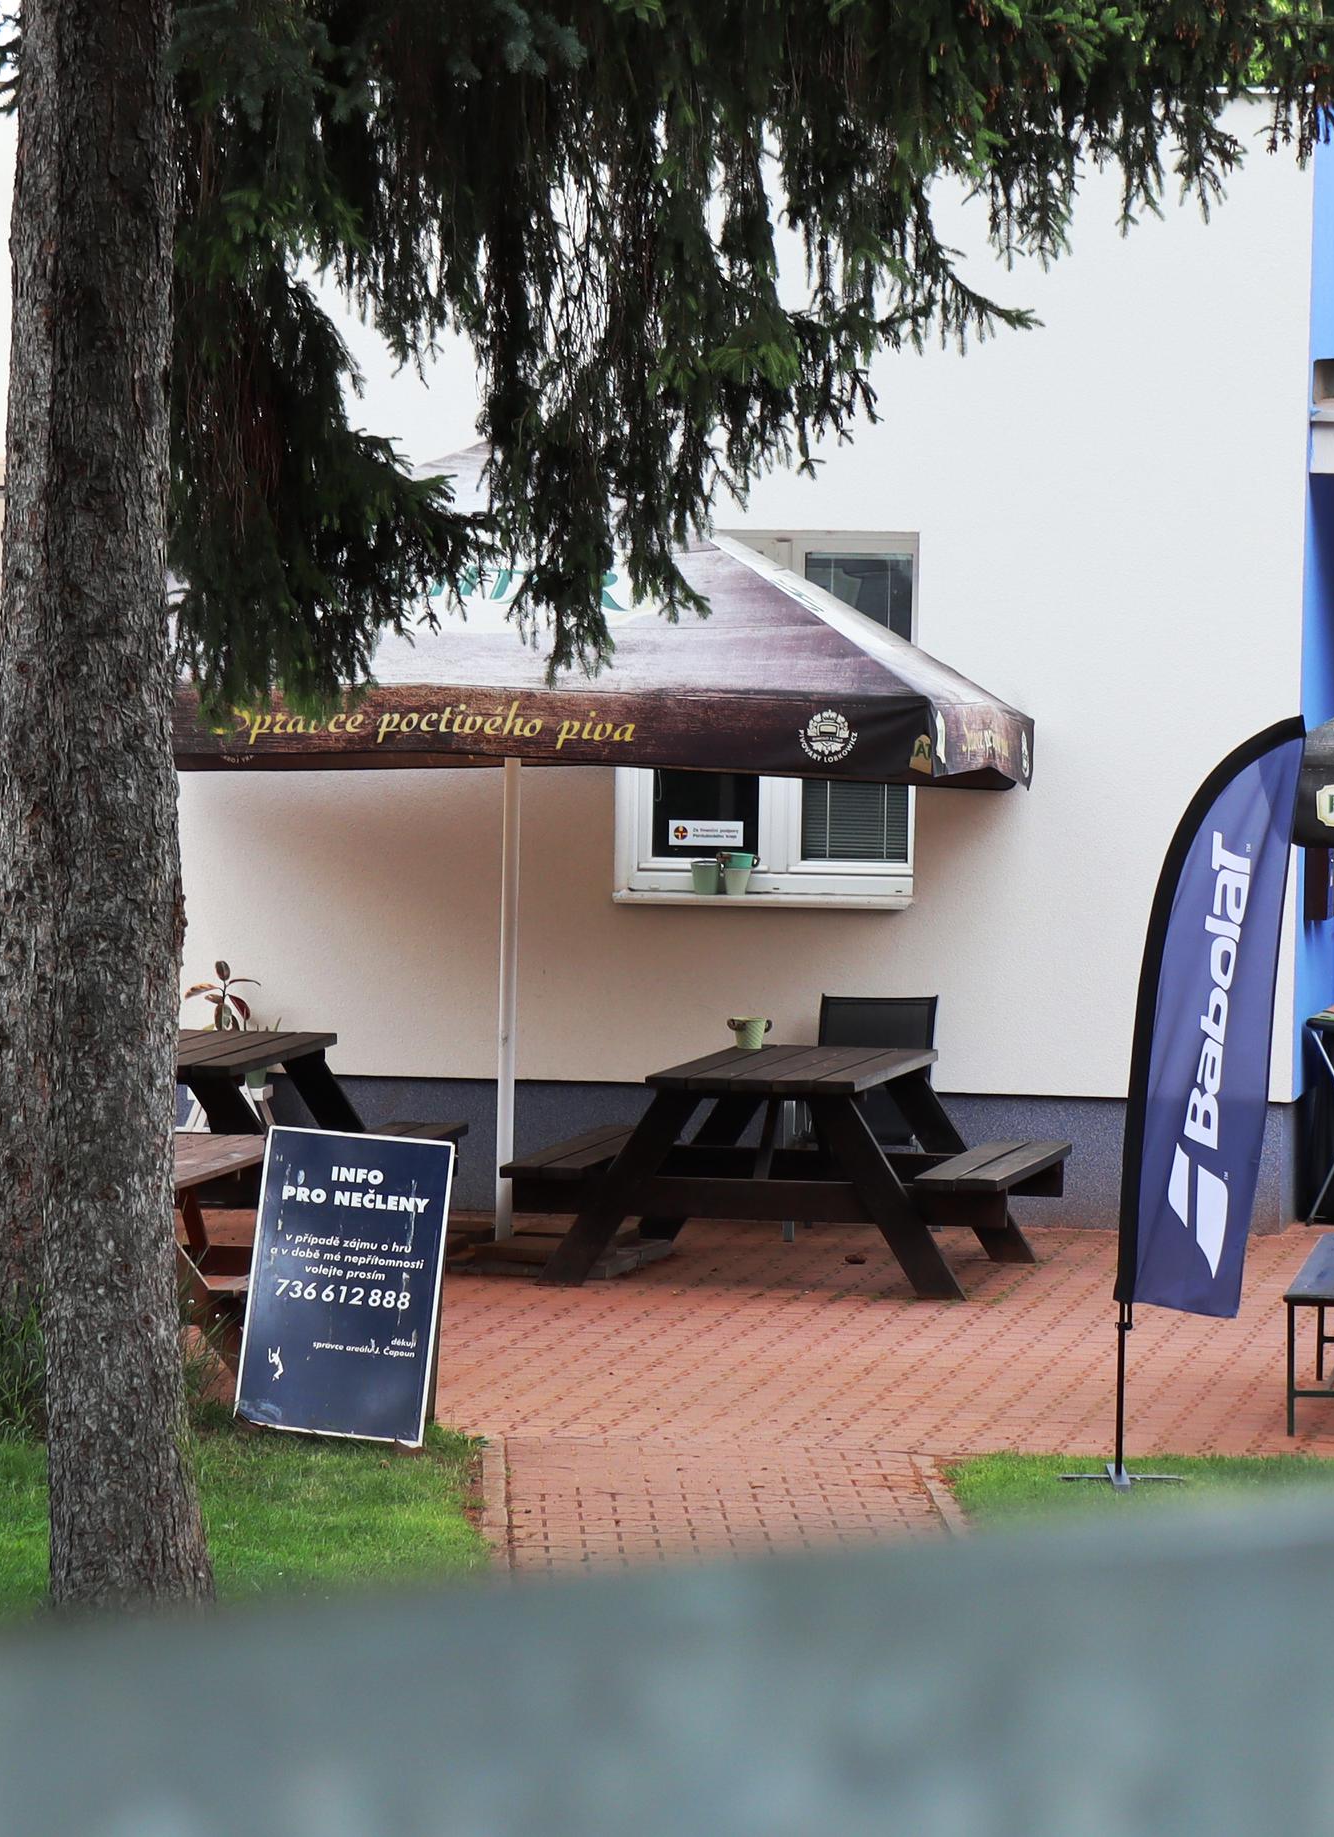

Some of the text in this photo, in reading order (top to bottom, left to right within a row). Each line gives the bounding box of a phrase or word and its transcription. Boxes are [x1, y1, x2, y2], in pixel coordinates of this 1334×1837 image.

[376, 701, 543, 744] poctivého
[555, 710, 636, 750] piva
[798, 729, 858, 763] PIVOVARY LOBKOWICZ
[1184, 831, 1251, 1150] Babolat
[331, 1166, 384, 1185] INFO
[282, 1185, 430, 1213] PRO NEČLENY
[295, 1234, 340, 1246] případě
[343, 1238, 378, 1251] zájmu
[391, 1242, 412, 1253] hru
[270, 1247, 277, 1255] a
[291, 1248, 320, 1259] době
[323, 1252, 341, 1261] mé
[343, 1254, 424, 1269] nepřítomnosti
[305, 1265, 385, 1281] volejte prosím
[275, 1278, 411, 1310] 736 612 888
